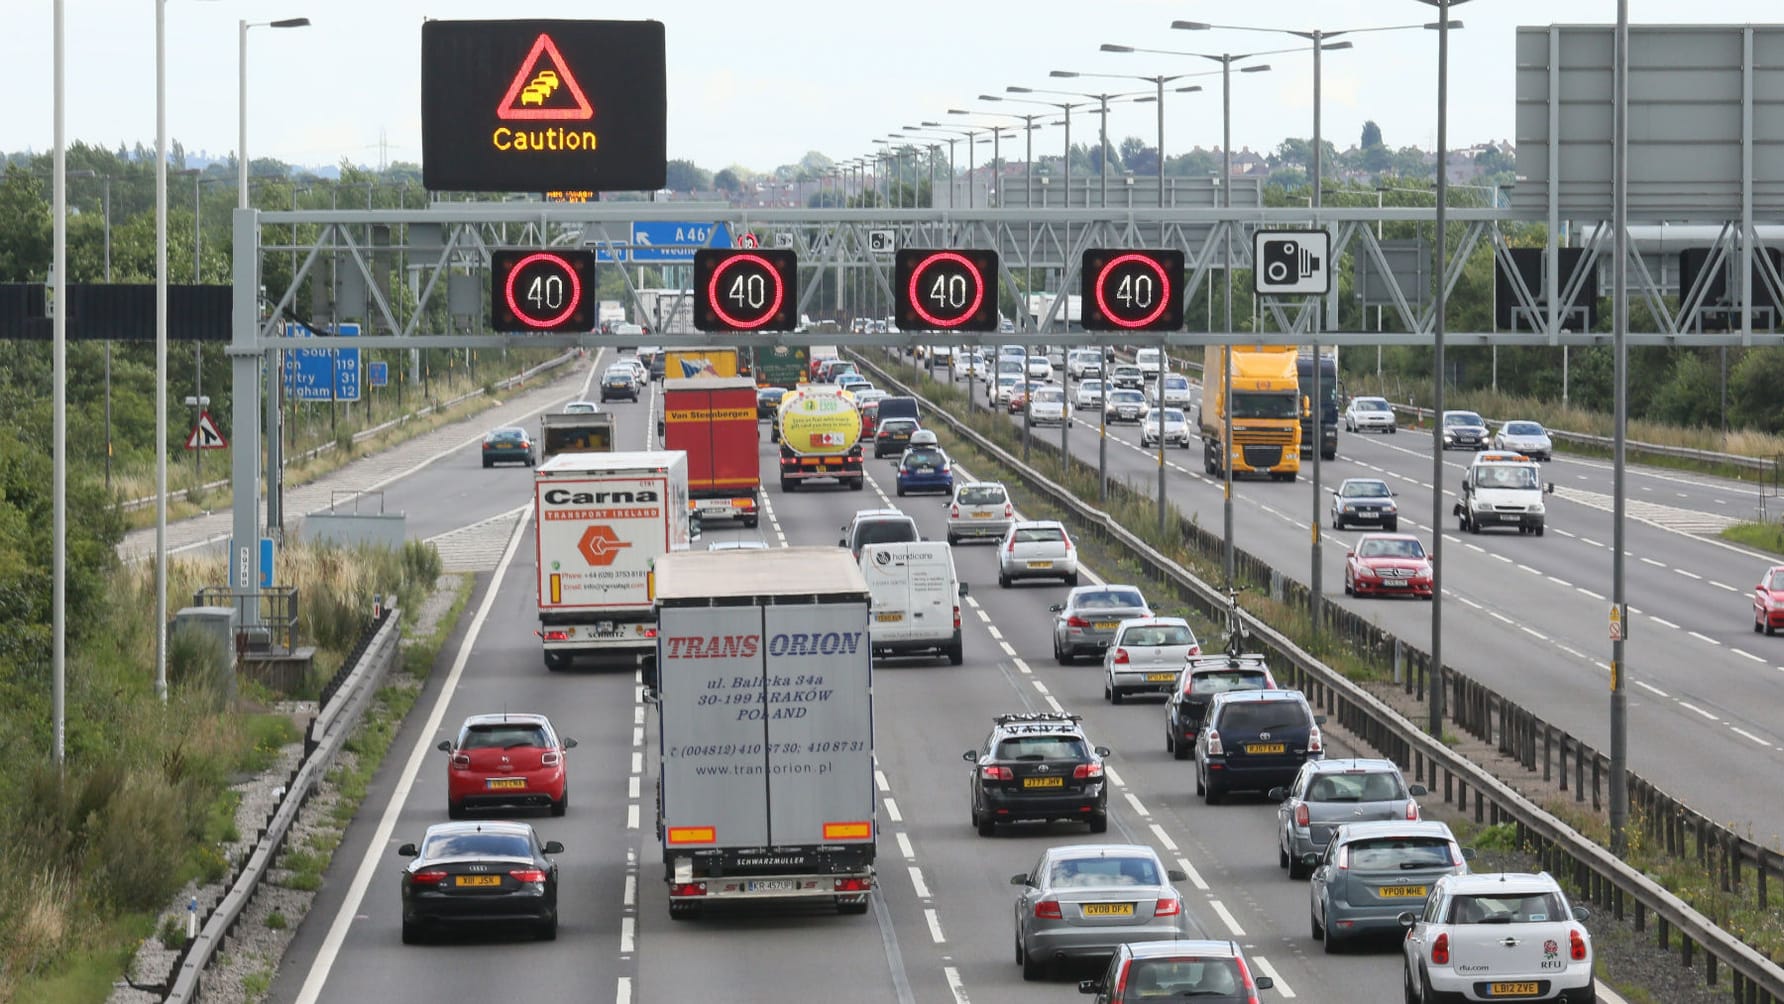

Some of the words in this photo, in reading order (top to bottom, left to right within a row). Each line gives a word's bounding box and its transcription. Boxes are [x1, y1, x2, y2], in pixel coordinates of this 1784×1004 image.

[493, 127, 597, 150] Caution
[528, 275, 562, 309] 40
[729, 274, 764, 309] 40
[930, 274, 966, 308] 40
[1116, 274, 1152, 308] 40
[336, 360, 355, 370] 119
[341, 372, 355, 384] 31
[342, 386, 355, 397] 12
[671, 411, 688, 420] Van
[691, 410, 749, 419] Steenbergen
[544, 489, 658, 505] Carna
[548, 511, 608, 519] TRANSPORT
[613, 509, 657, 518] IRELAND
[892, 551, 933, 561] handicare
[667, 635, 760, 659] TRANS
[769, 632, 862, 657] ORION
[707, 677, 727, 689] ul.
[795, 675, 823, 687] 34a
[698, 693, 752, 706] 30-199
[756, 690, 833, 704] KRAKÓW
[739, 744, 761, 755] 410
[1111, 904, 1128, 914] DFX
[1459, 963, 1489, 972] rfu.com
[1541, 960, 1561, 969] RFU
[1494, 983, 1515, 994] LB12
[1517, 983, 1534, 994] ZVE
